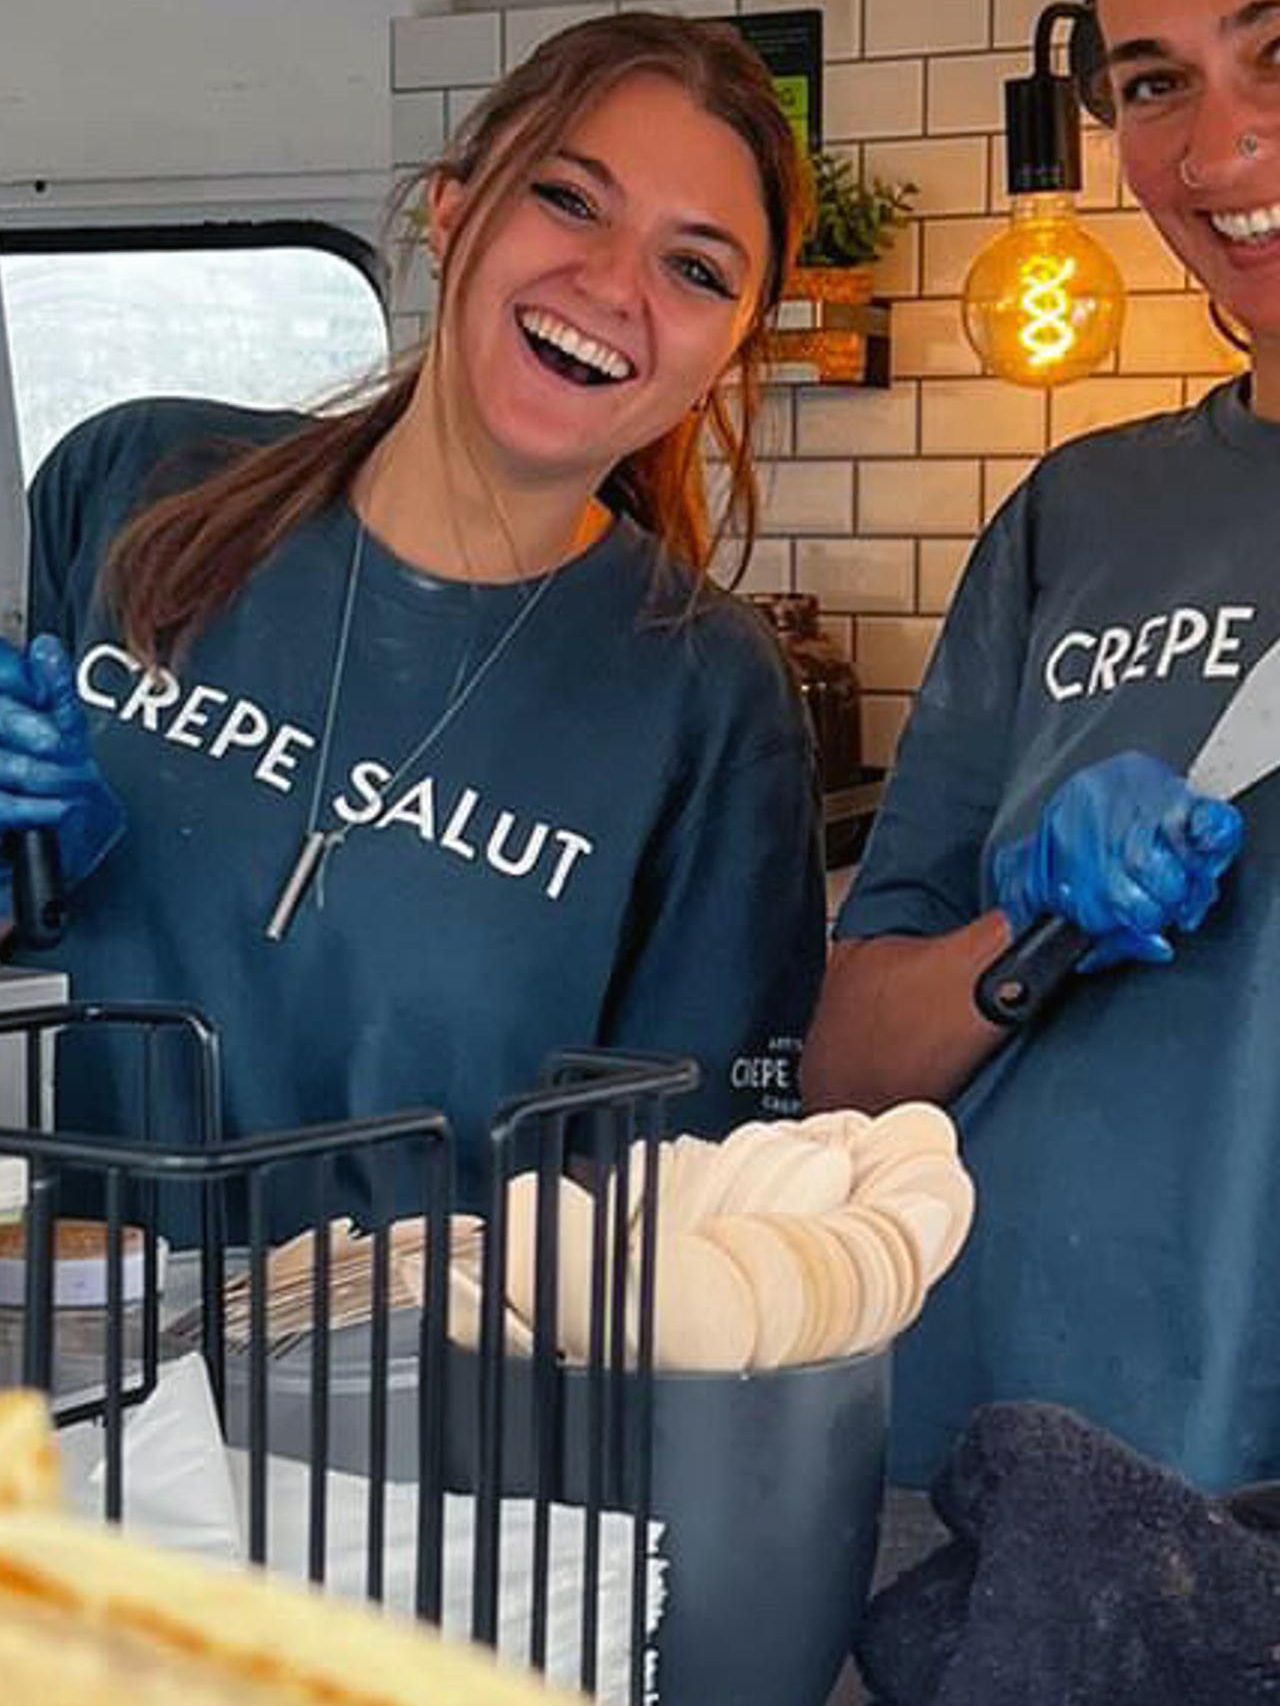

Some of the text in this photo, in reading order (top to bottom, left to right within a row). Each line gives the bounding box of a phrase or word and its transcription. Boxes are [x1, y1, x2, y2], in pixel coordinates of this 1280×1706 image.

[1044, 606, 1256, 702] CREPE
[75, 642, 594, 900] CREPE SALUT
